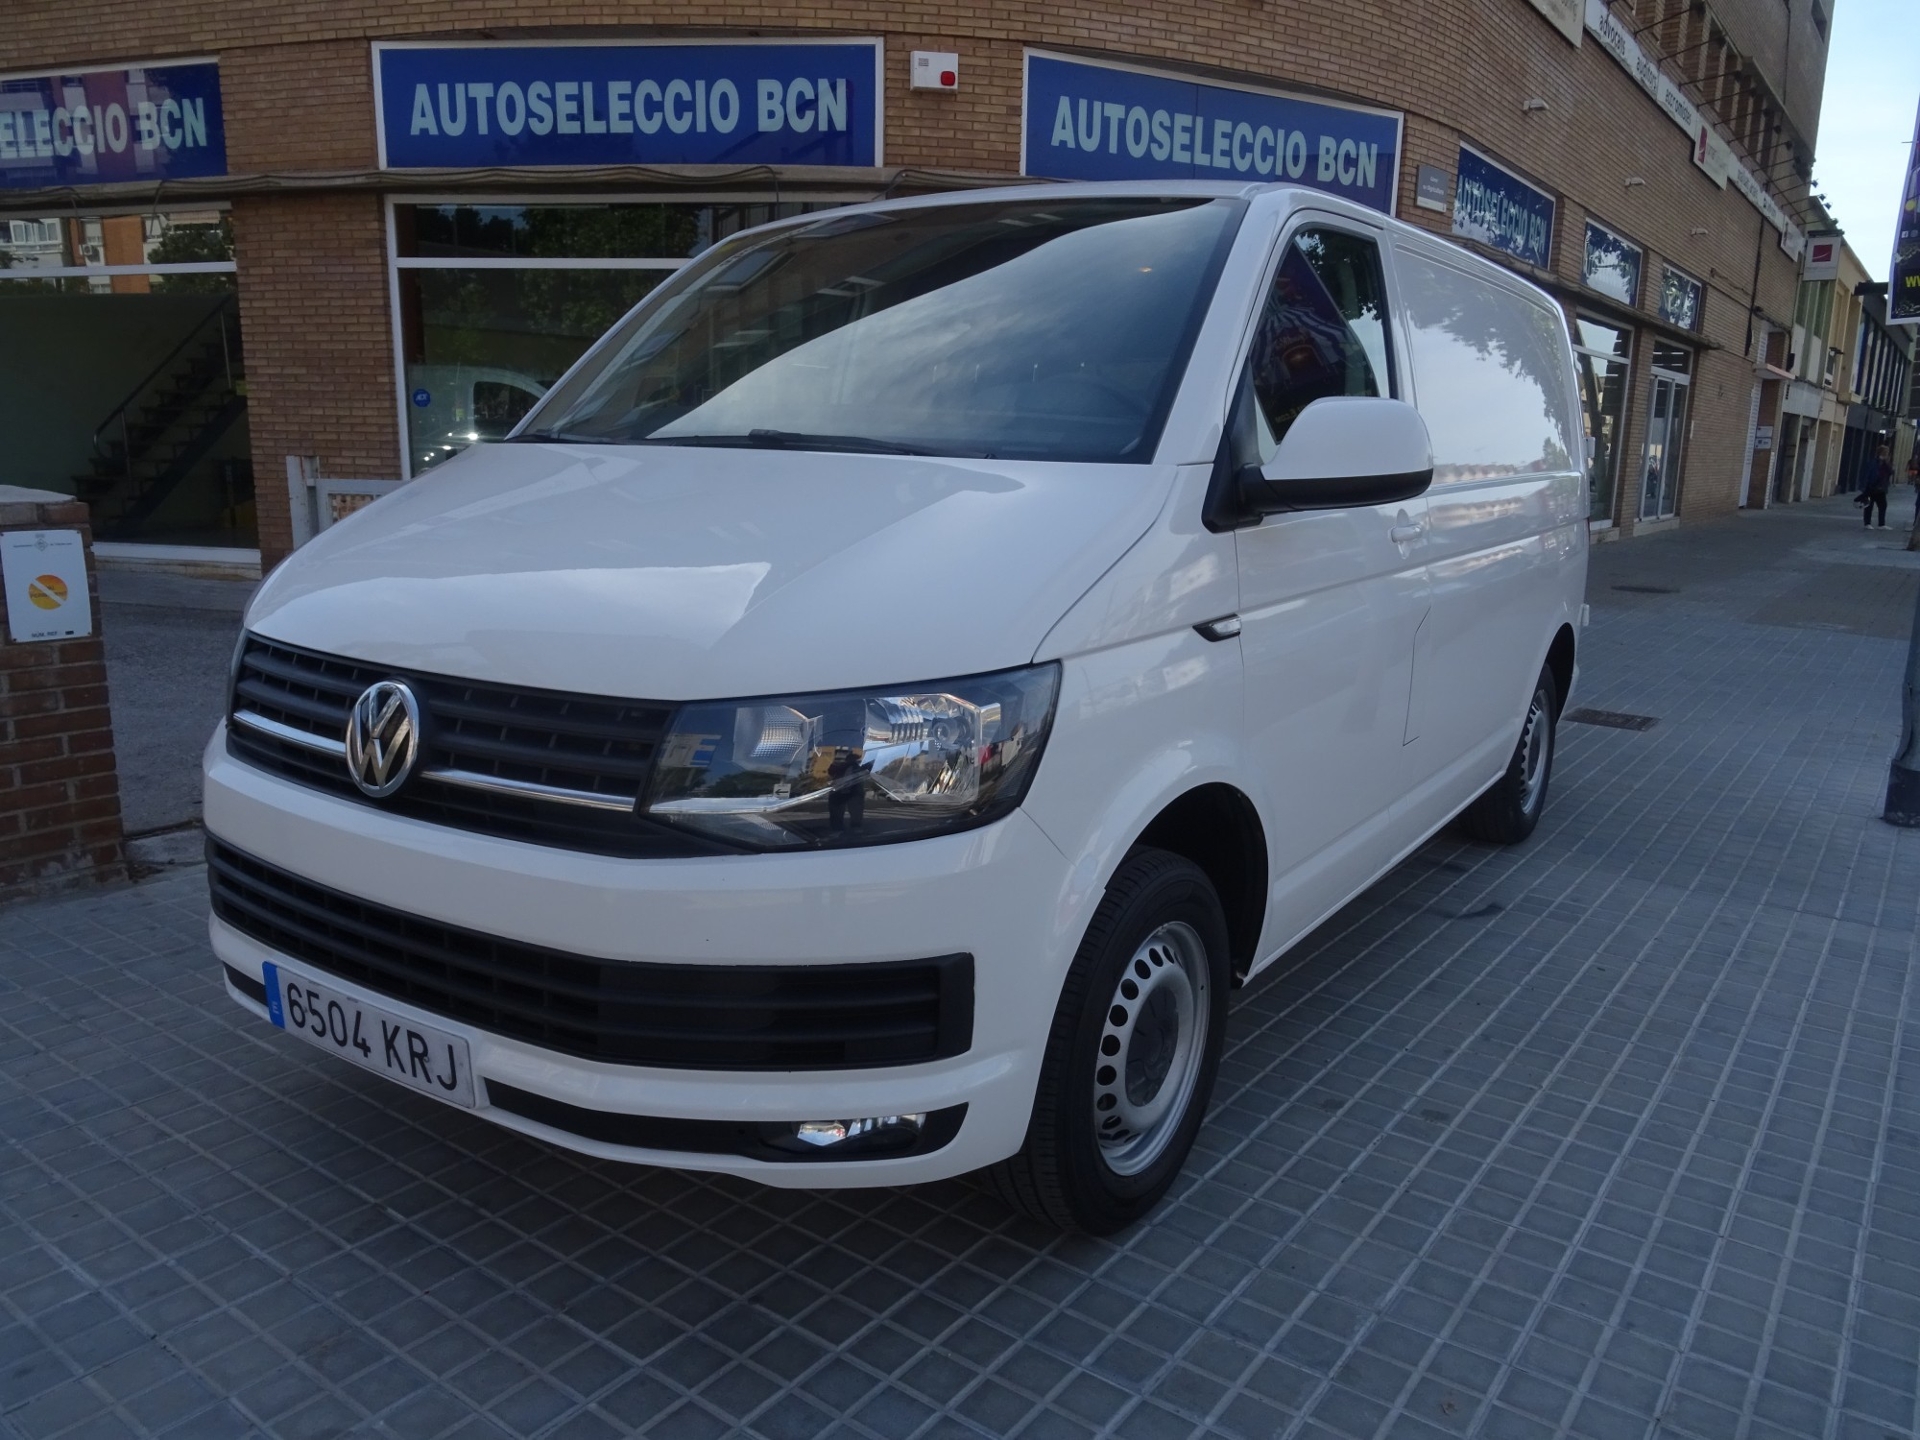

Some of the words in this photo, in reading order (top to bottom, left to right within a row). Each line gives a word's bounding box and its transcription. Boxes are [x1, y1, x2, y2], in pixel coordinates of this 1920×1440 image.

[138, 97, 207, 150] BCN
[410, 79, 739, 136] AUTOSELECCIO
[758, 78, 846, 132] BCN
[1051, 96, 1306, 179] AUTOSELECCIO
[1317, 135, 1377, 188] BCN
[1455, 175, 1527, 244] AUTOSELECCIO
[1528, 213, 1547, 254] BCN
[287, 982, 371, 1058] 6504
[382, 1020, 458, 1091] KRJ
